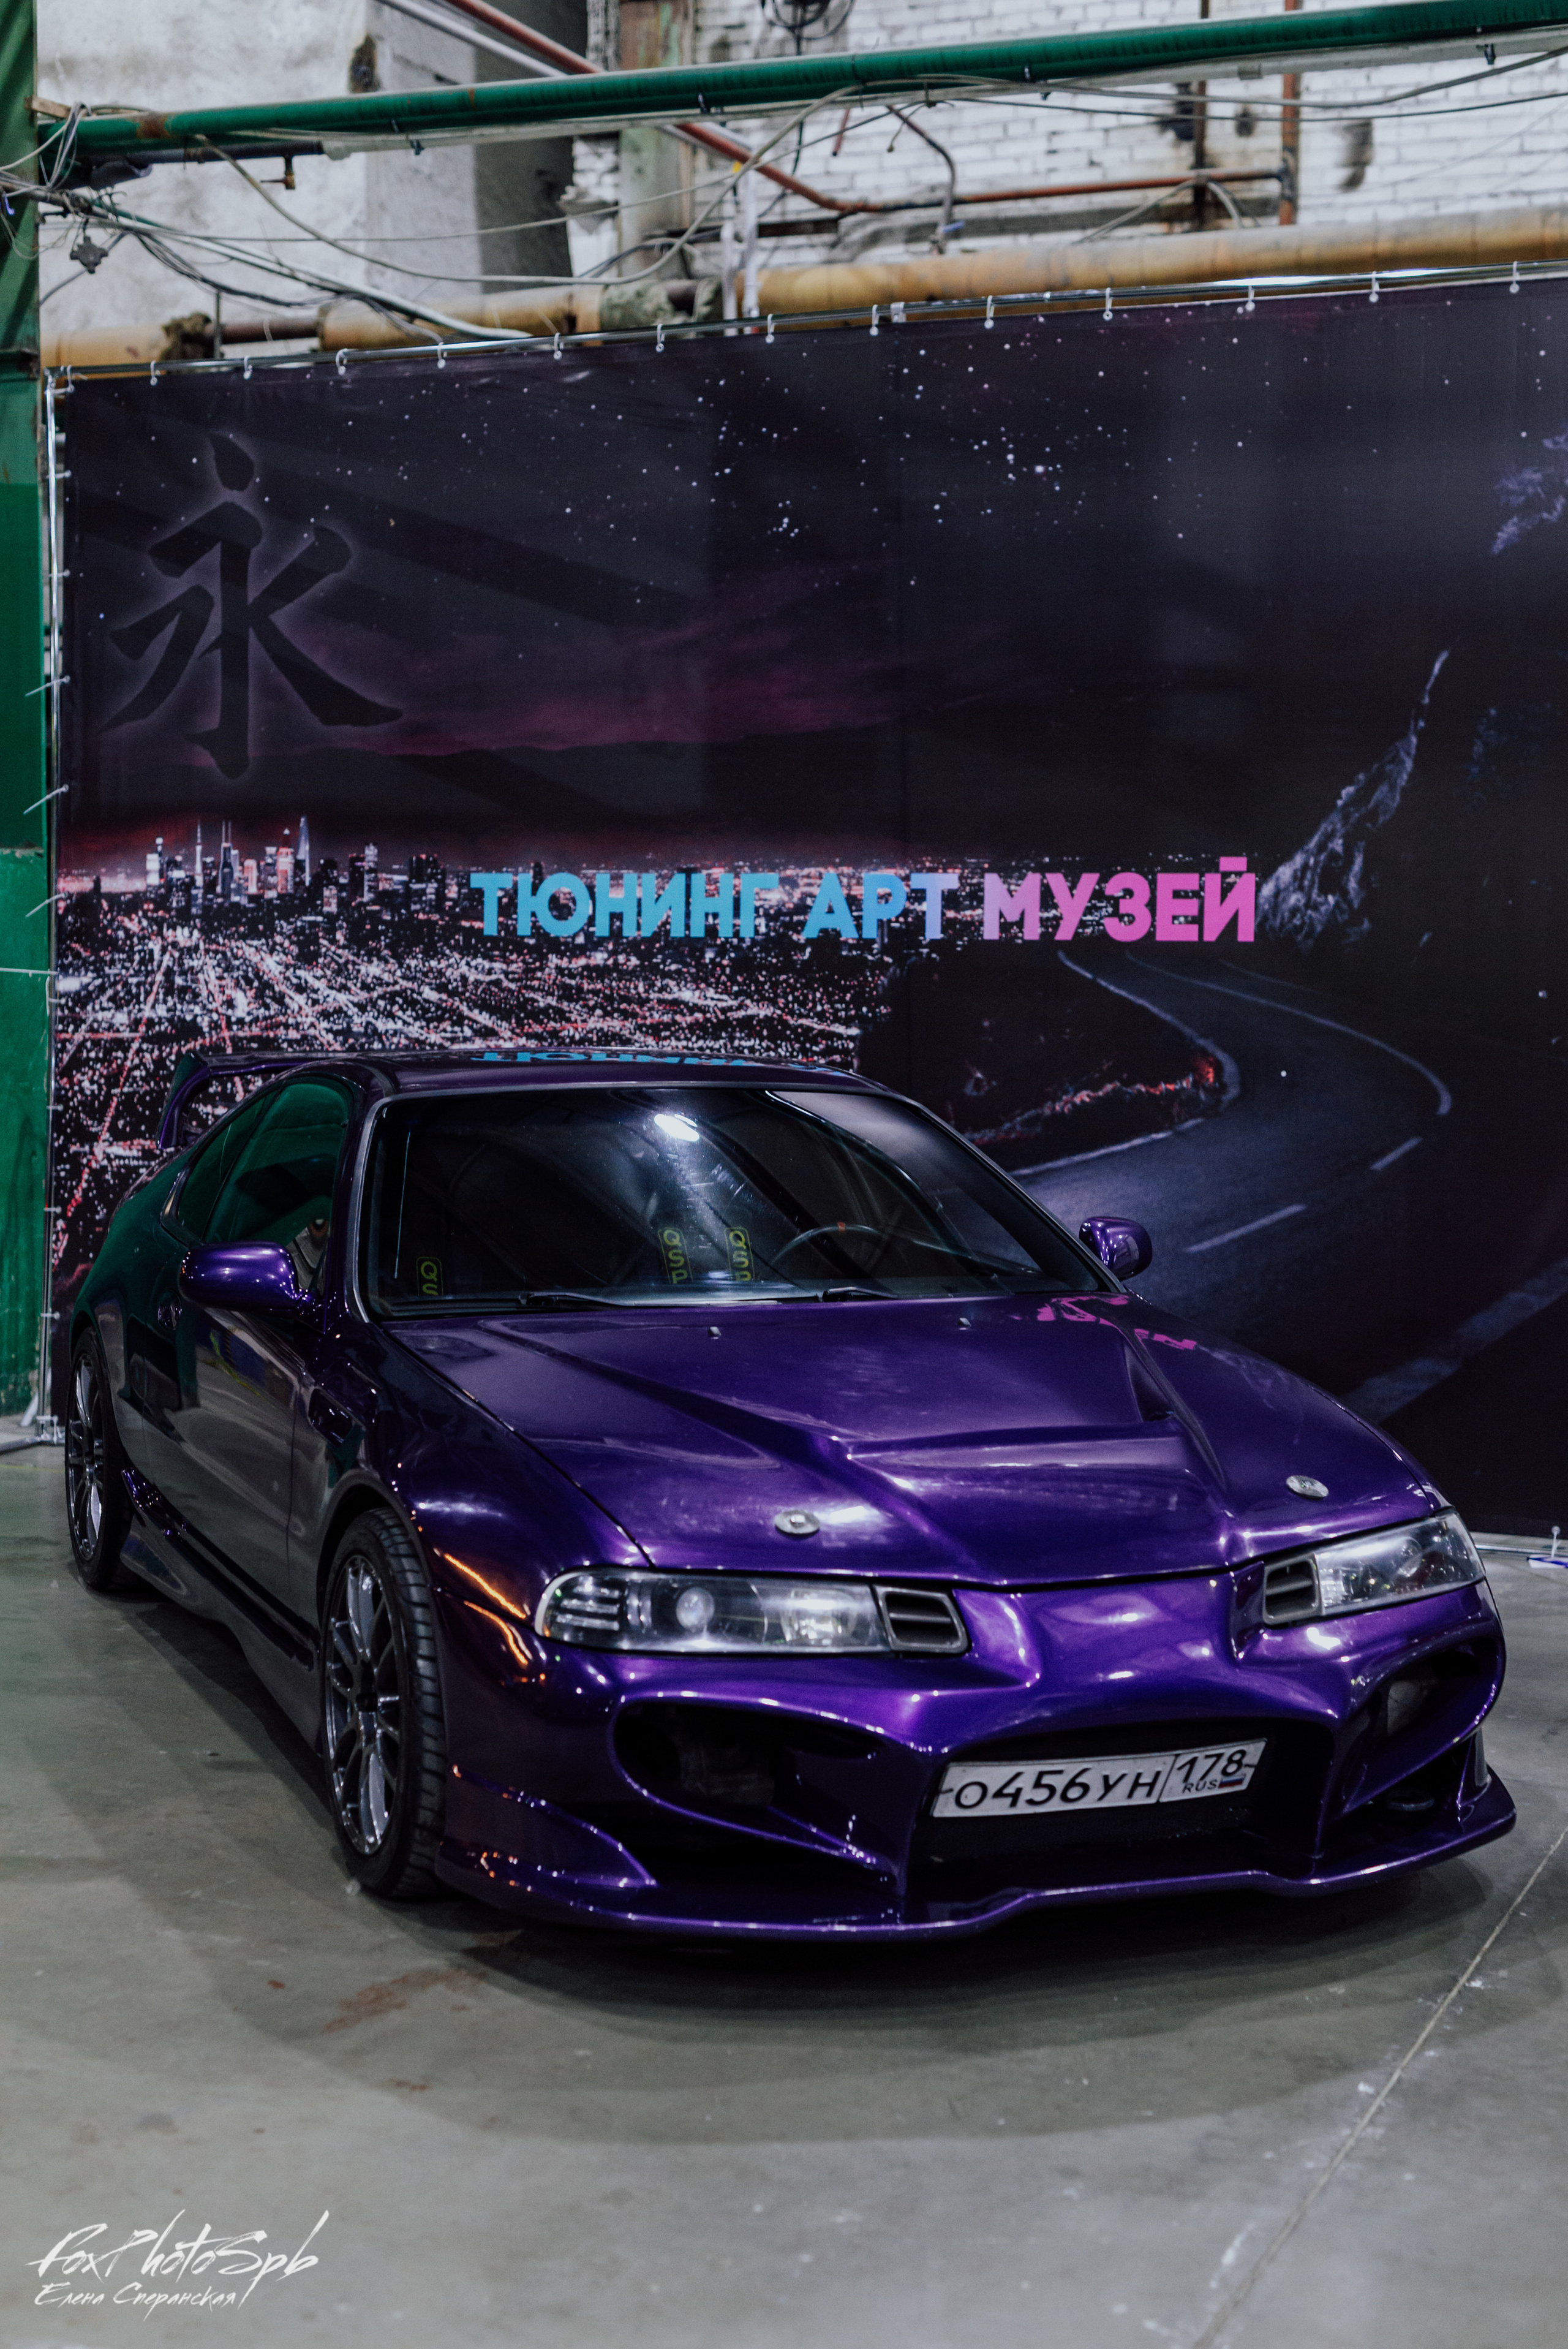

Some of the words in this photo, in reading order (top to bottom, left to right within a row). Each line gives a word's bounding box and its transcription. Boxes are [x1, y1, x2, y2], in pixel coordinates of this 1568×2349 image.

[101, 431, 404, 780] 永
[470, 873, 780, 937] ТЮНИНГ
[803, 873, 959, 939] АРТ
[982, 857, 1256, 942] МУЗЕЙ
[663, 1230, 688, 1284] QSP
[1177, 1749, 1247, 1783] 178
[1182, 1779, 1218, 1793] RUS
